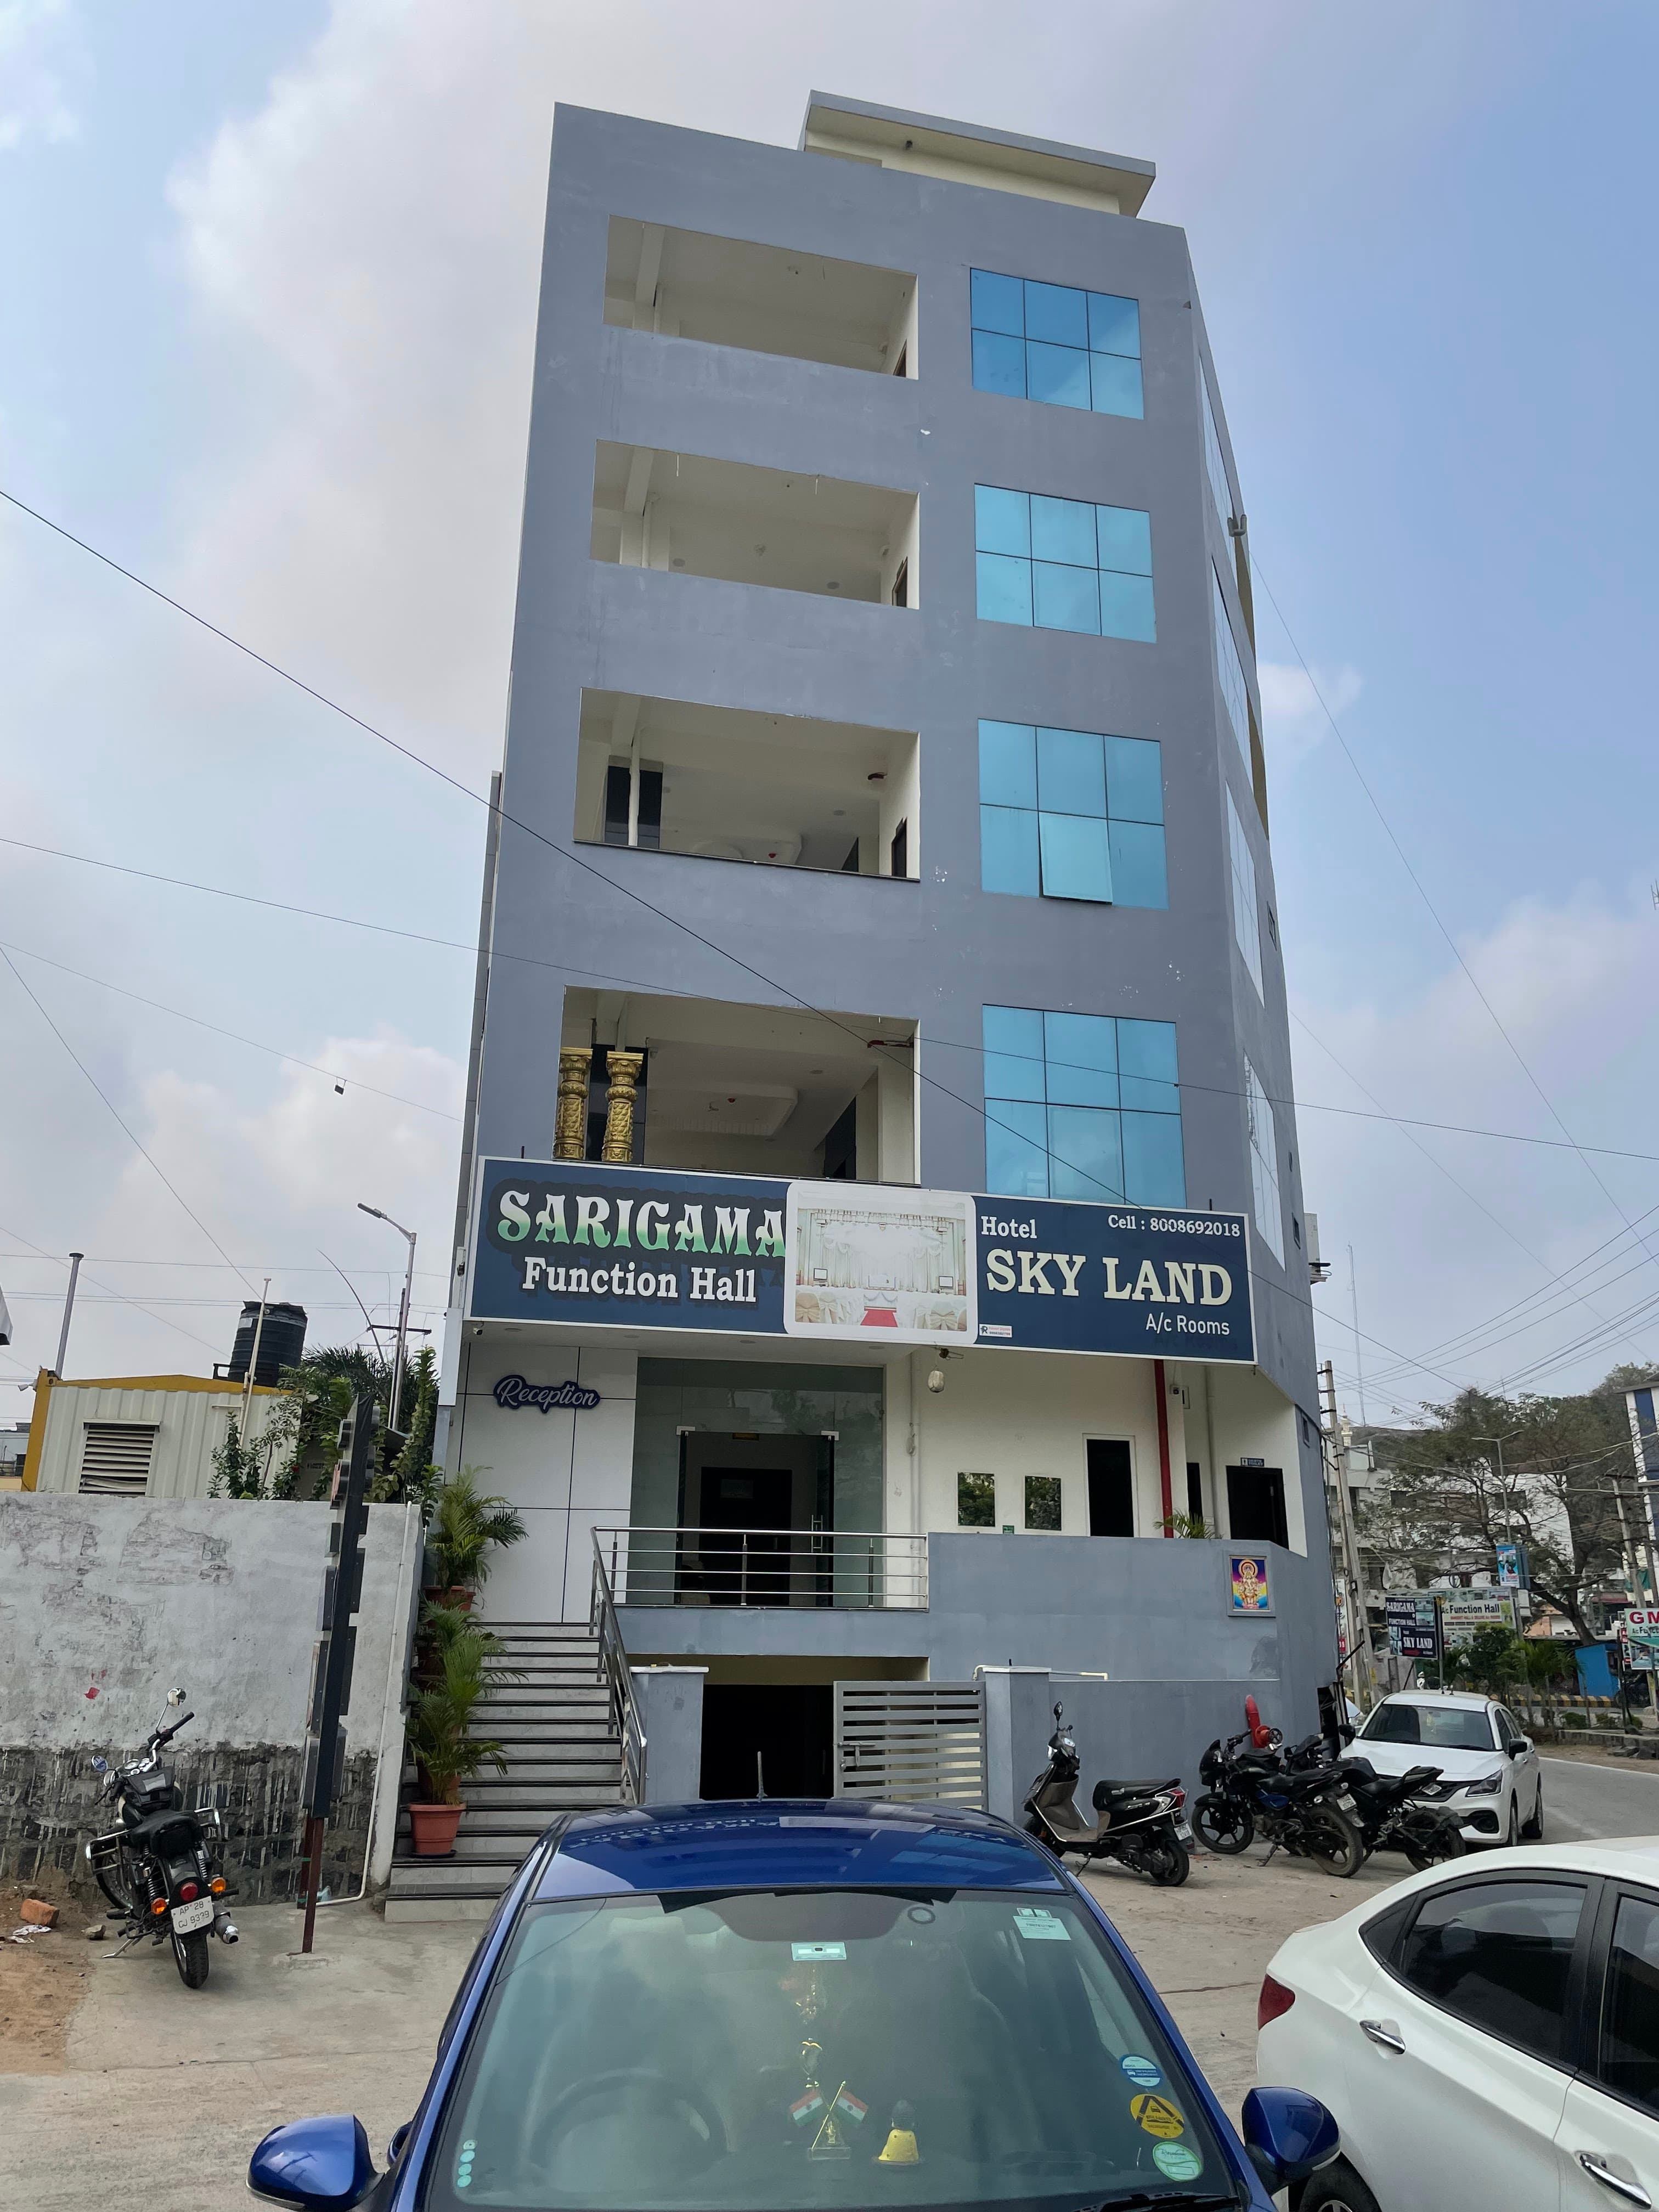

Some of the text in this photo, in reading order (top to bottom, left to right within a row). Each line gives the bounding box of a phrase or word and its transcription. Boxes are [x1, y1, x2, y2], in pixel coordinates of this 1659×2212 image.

[497, 1190, 786, 1257] SARIGAMA
[981, 1215, 1037, 1239] Hotel
[1108, 1215, 1137, 1230] Cell
[1150, 1217, 1240, 1237] 8008692018
[522, 1256, 757, 1302] Function Hall
[986, 1248, 1233, 1306] SKY LAND
[1146, 1312, 1230, 1335] A/c Rooms
[496, 1378, 597, 1410] Reception
[1449, 1604, 1482, 1613] Function
[1484, 1604, 1500, 1613] Hall
[1403, 1637, 1432, 1649] SKY LAND
[179, 1901, 204, 1915] AP 28
